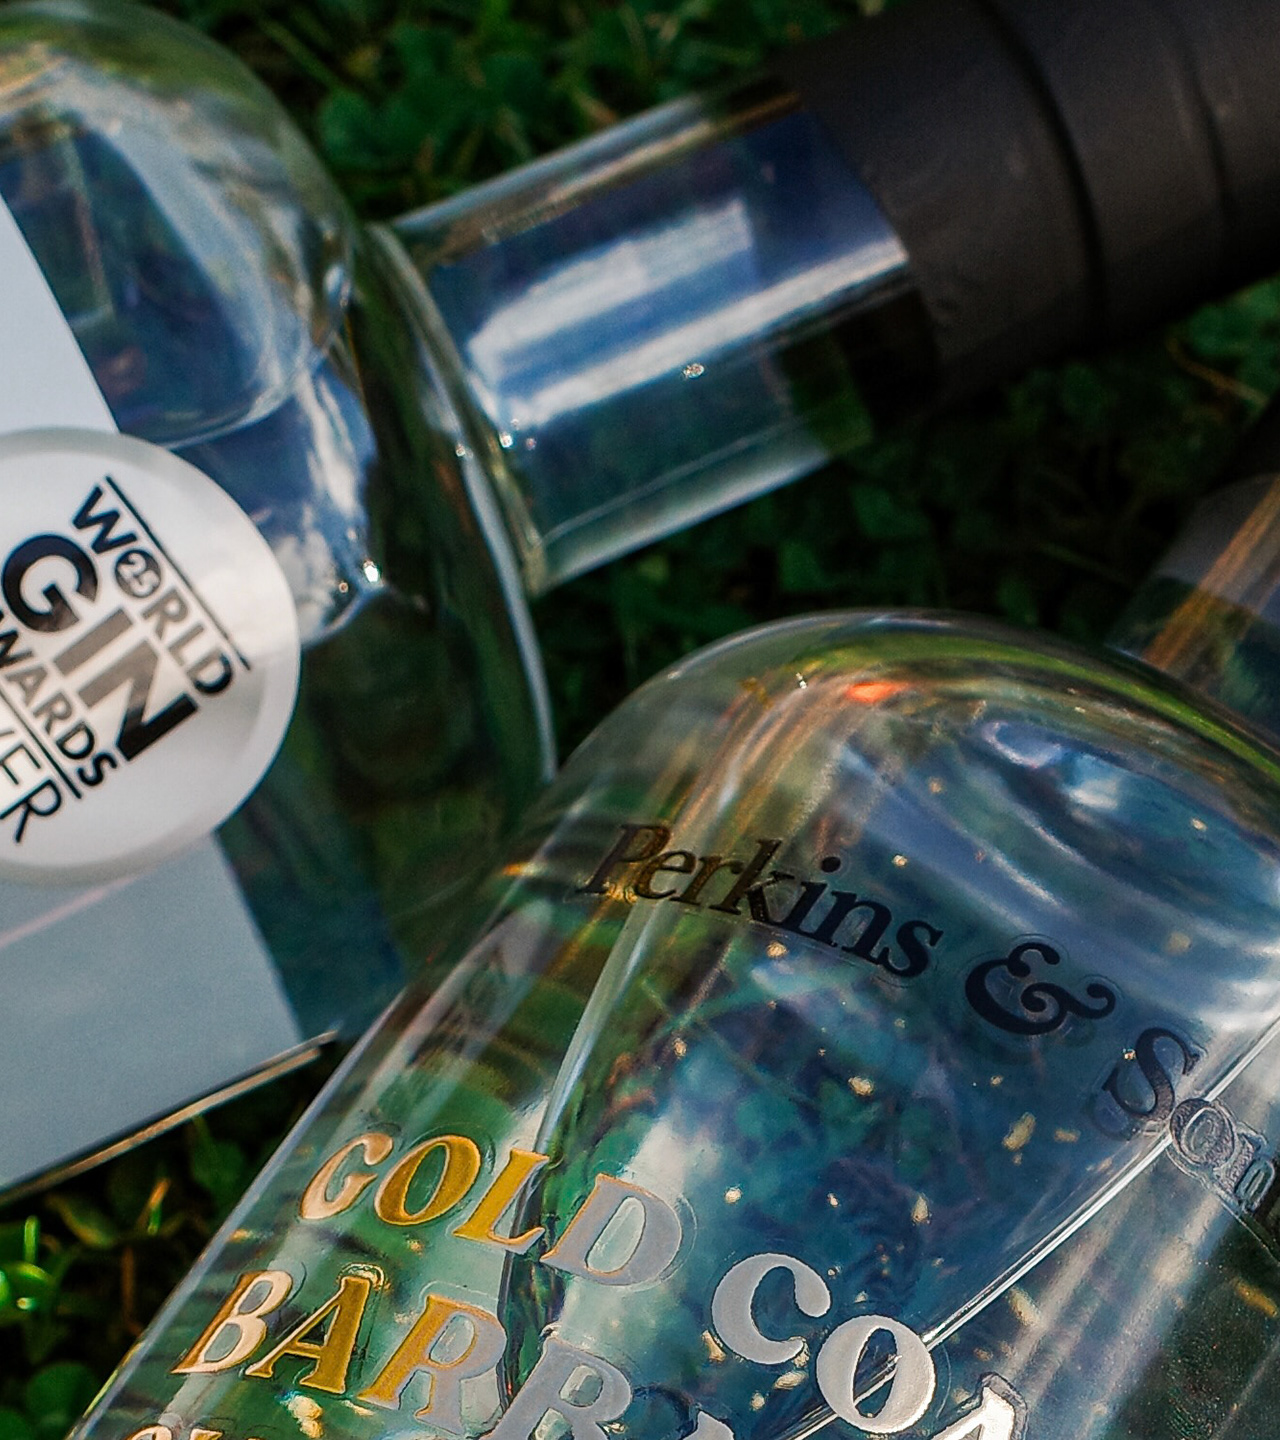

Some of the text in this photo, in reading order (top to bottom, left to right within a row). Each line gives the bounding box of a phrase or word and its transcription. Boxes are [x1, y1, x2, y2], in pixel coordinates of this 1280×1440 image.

[1, 534, 199, 762] GIN
[575, 823, 943, 979] Perkins
[964, 941, 1116, 1036] &
[299, 1131, 682, 1286] GOLD
